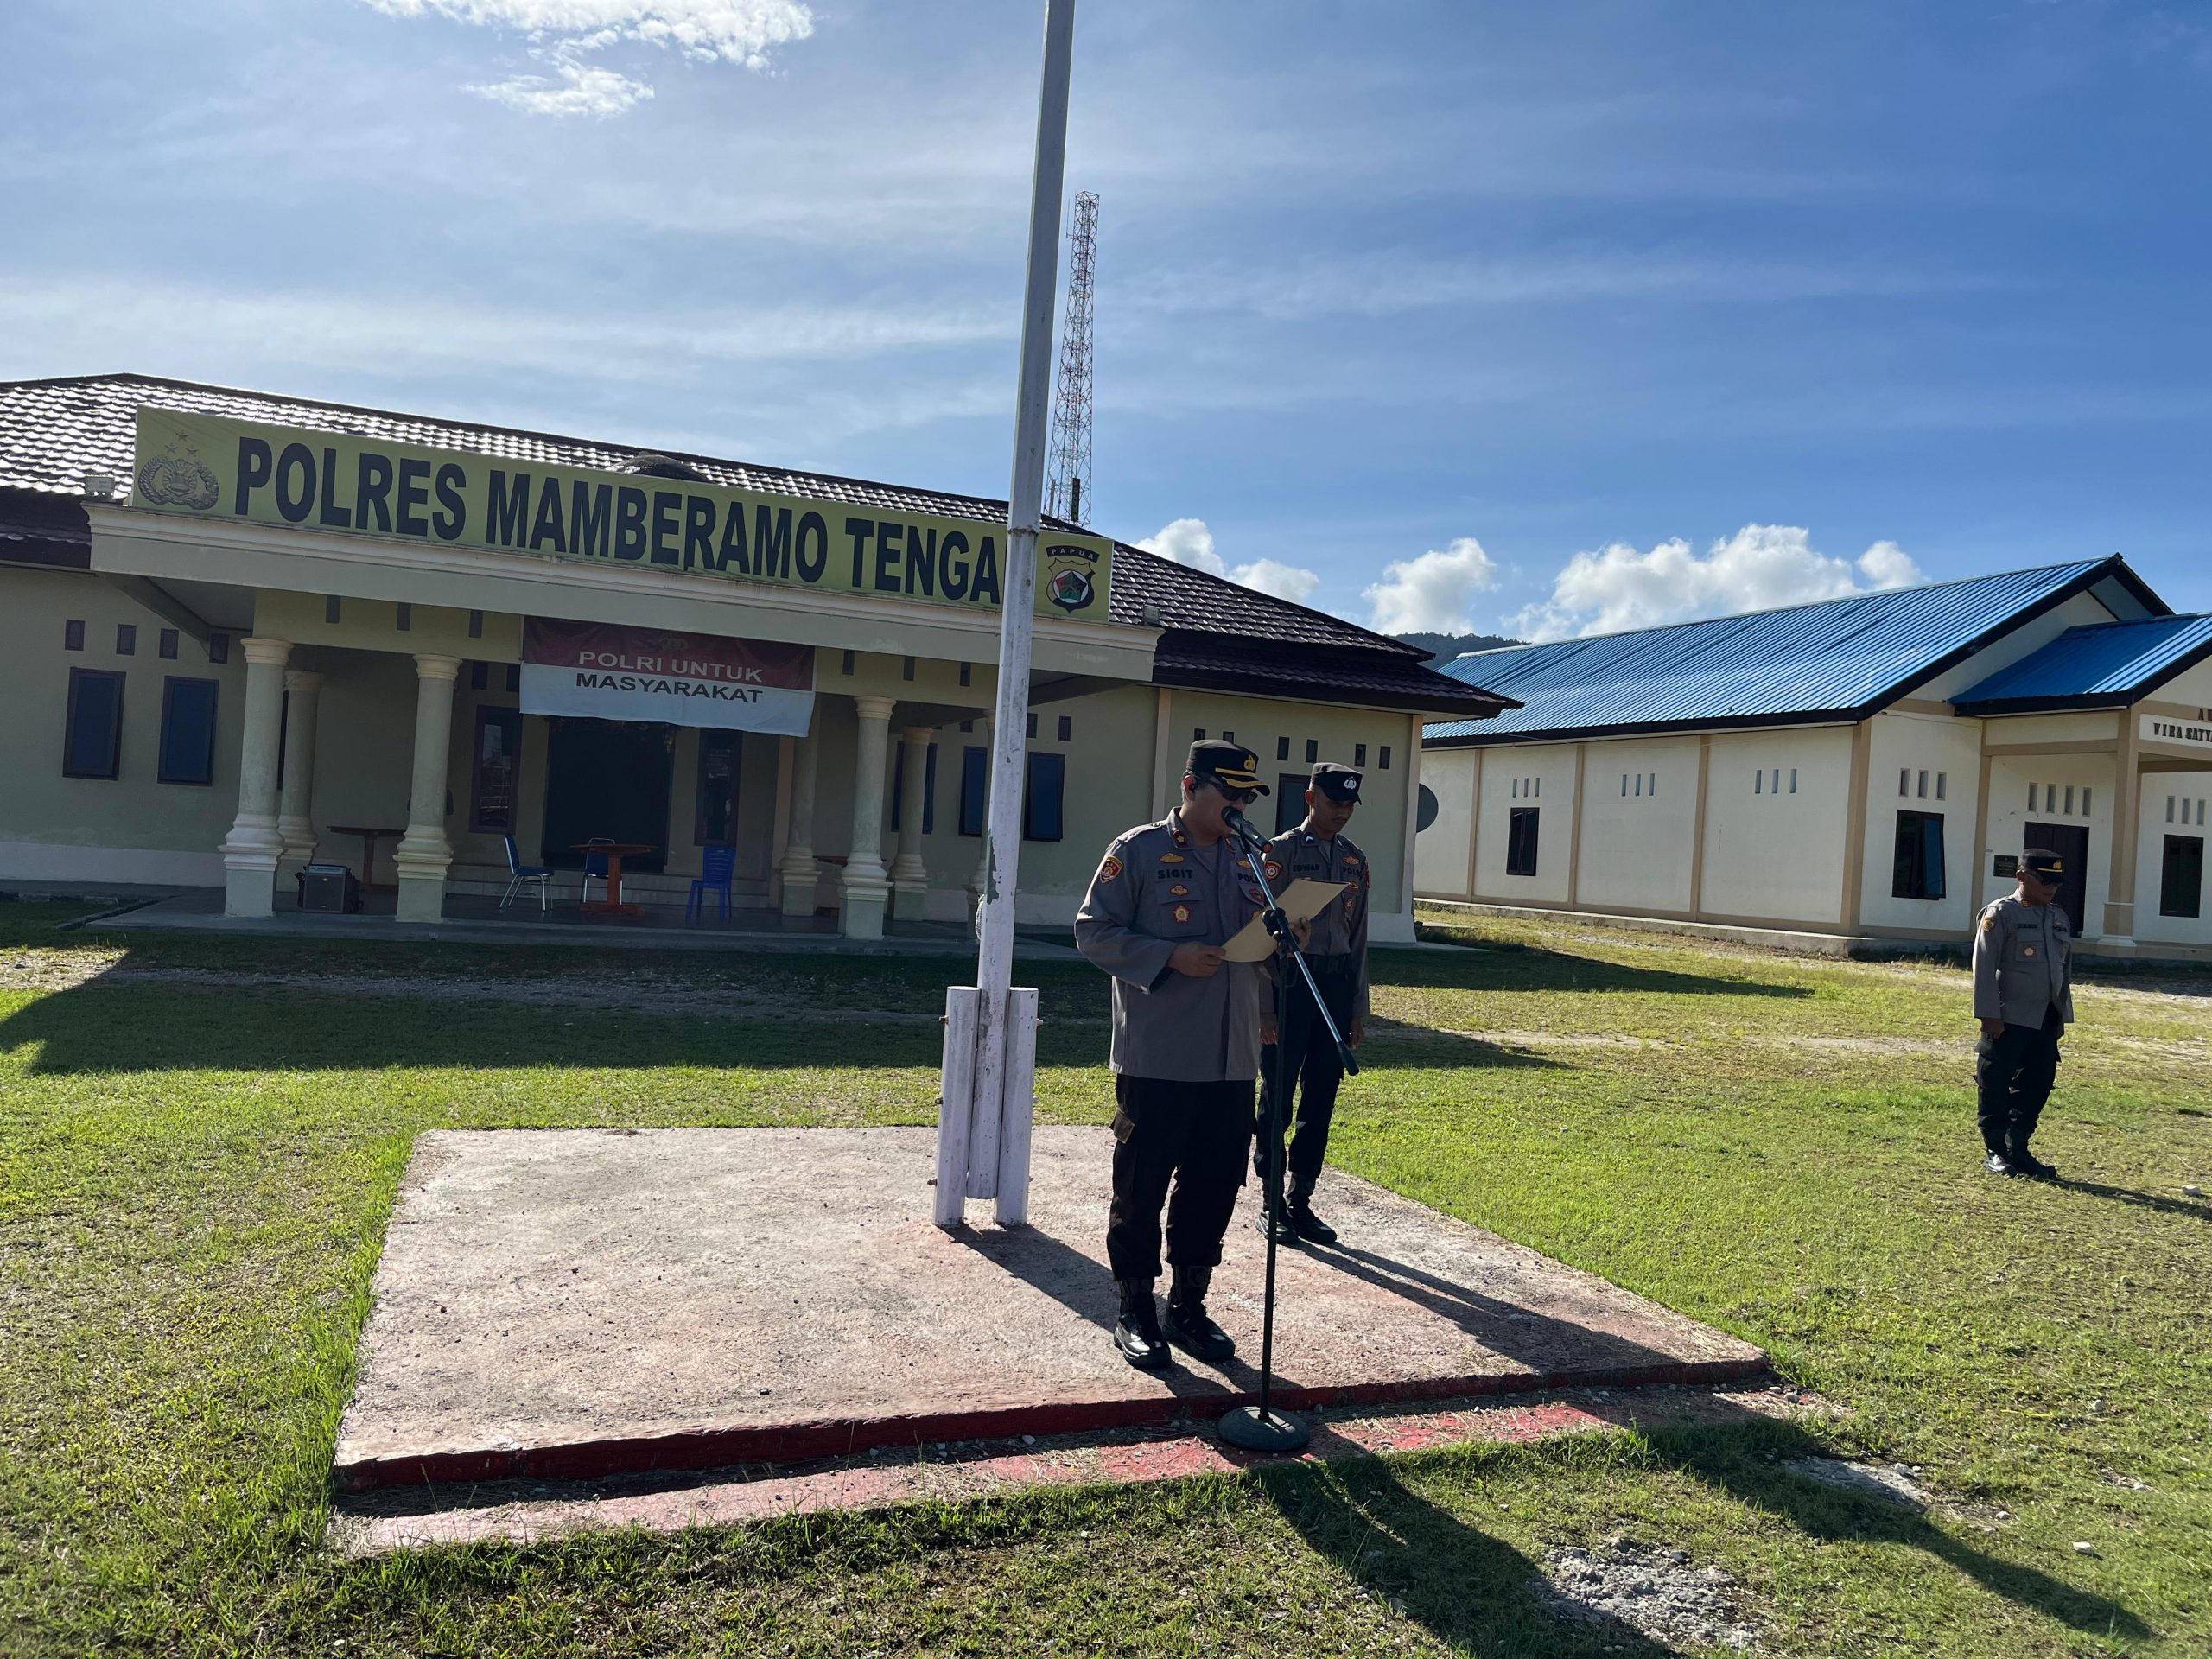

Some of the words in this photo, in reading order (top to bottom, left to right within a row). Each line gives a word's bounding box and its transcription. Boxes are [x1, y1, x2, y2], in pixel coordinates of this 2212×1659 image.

[234, 436, 467, 541] POLRES
[486, 469, 828, 583] MAMBERAMO
[845, 517, 1008, 605] TENGA
[1051, 548, 1094, 560] PAPUA
[578, 651, 662, 671] POLRI
[671, 659, 763, 683] UNTUK
[576, 672, 764, 704] MASYARAKAT
[2185, 728, 2212, 743] SATY
[1157, 868, 1192, 880] SIGIT
